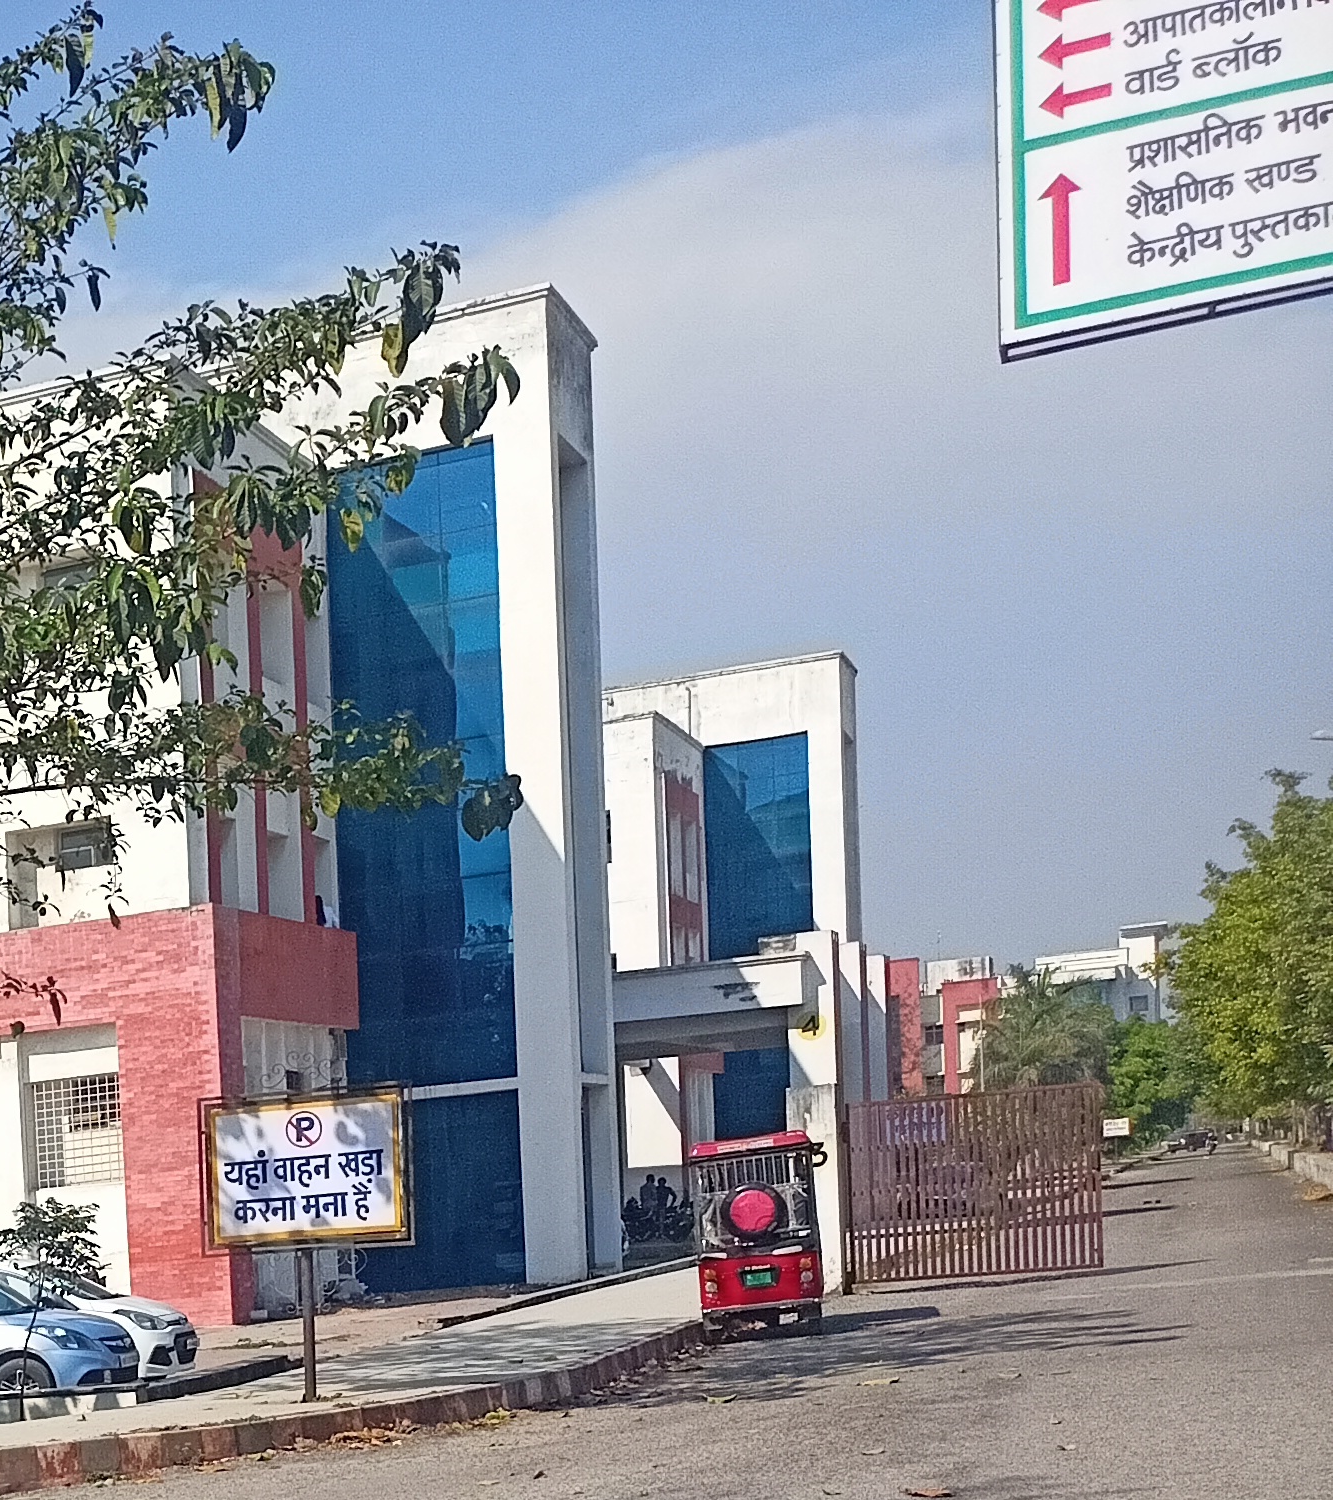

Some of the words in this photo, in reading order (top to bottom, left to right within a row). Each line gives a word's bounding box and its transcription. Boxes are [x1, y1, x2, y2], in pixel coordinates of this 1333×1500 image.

[1124, 48, 1182, 96] वार्ड
[1191, 32, 1282, 80] ब्लॉक
[1126, 113, 1266, 173] प्रशासनिक
[1125, 171, 1235, 220] शैक्षणिक
[1244, 153, 1322, 194] खण्ड
[1127, 222, 1225, 268] केन्द्रीय
[1228, 201, 1333, 259] पुस्तका
[224, 1149, 269, 1190] यहां
[273, 1153, 331, 1188] वाहन
[234, 1196, 297, 1224] करना
[300, 1191, 349, 1219] मना
